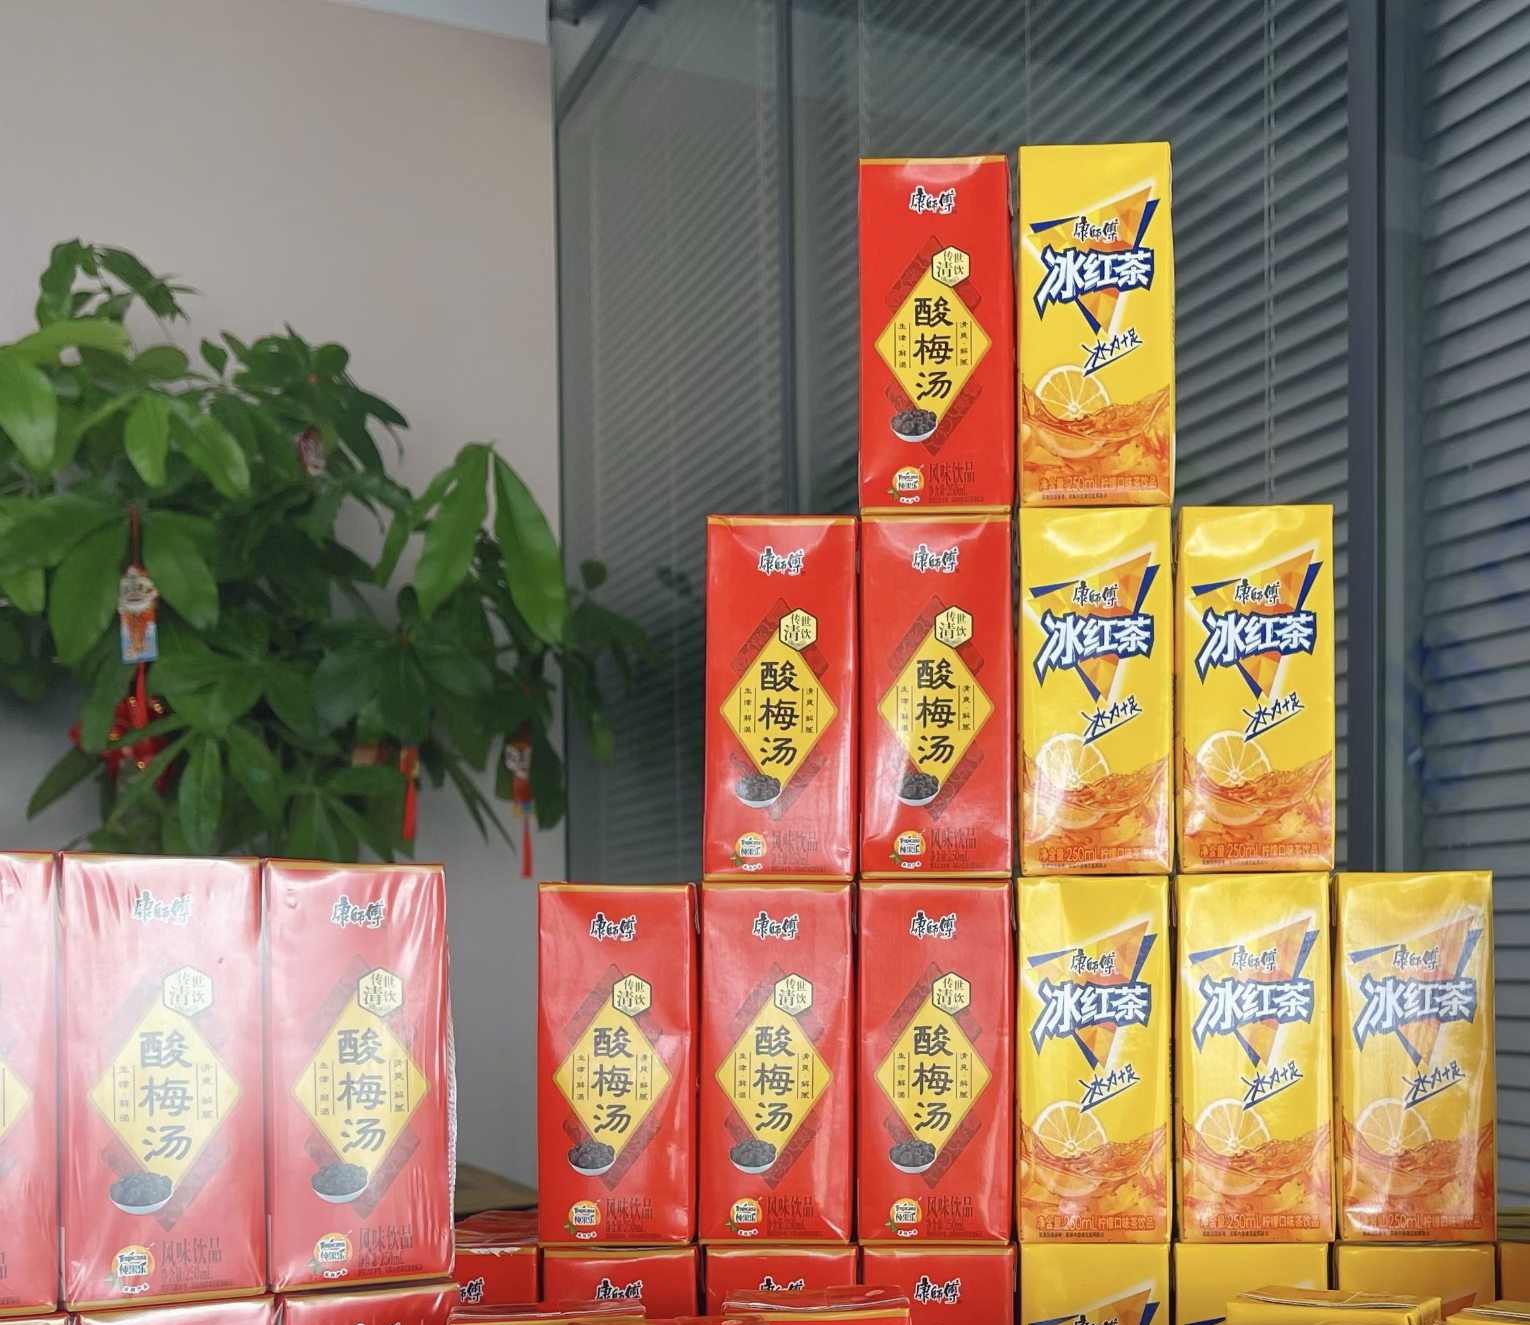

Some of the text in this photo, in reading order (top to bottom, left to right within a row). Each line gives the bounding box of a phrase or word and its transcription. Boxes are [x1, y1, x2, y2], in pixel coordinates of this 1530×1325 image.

[1036, 250, 1151, 312] 冰红茶
[912, 294, 955, 400] 酸梅汤
[1081, 327, 1143, 366] 冰力十足
[929, 461, 975, 483] 风味饮品
[1035, 617, 1151, 681] 冰红茶
[1196, 614, 1313, 678] 冰红茶
[757, 659, 800, 767] 酸梅汤
[914, 656, 957, 765] 酸梅汤
[1081, 694, 1143, 736] 冰力十足
[1242, 691, 1305, 733] 冰力十足
[931, 827, 976, 848] 风味饮品
[1032, 983, 1148, 1047] 冰红茶
[1194, 981, 1310, 1044] 冰红茶
[1355, 979, 1473, 1043] 冰红茶
[137, 1028, 194, 1162] 酸梅汤
[336, 1026, 387, 1154] 酸梅汤
[590, 1025, 634, 1135] 酸梅汤
[752, 1024, 796, 1133] 酸梅汤
[911, 1023, 954, 1133] 酸梅汤
[1078, 1063, 1140, 1103] 冰力十足
[1241, 1059, 1304, 1101] 冰力十足
[1402, 1059, 1465, 1100] 冰力十足
[767, 1195, 814, 1217] 风味饮品
[927, 1195, 973, 1217] 风味饮品
[358, 1224, 413, 1252] 风味饮品
